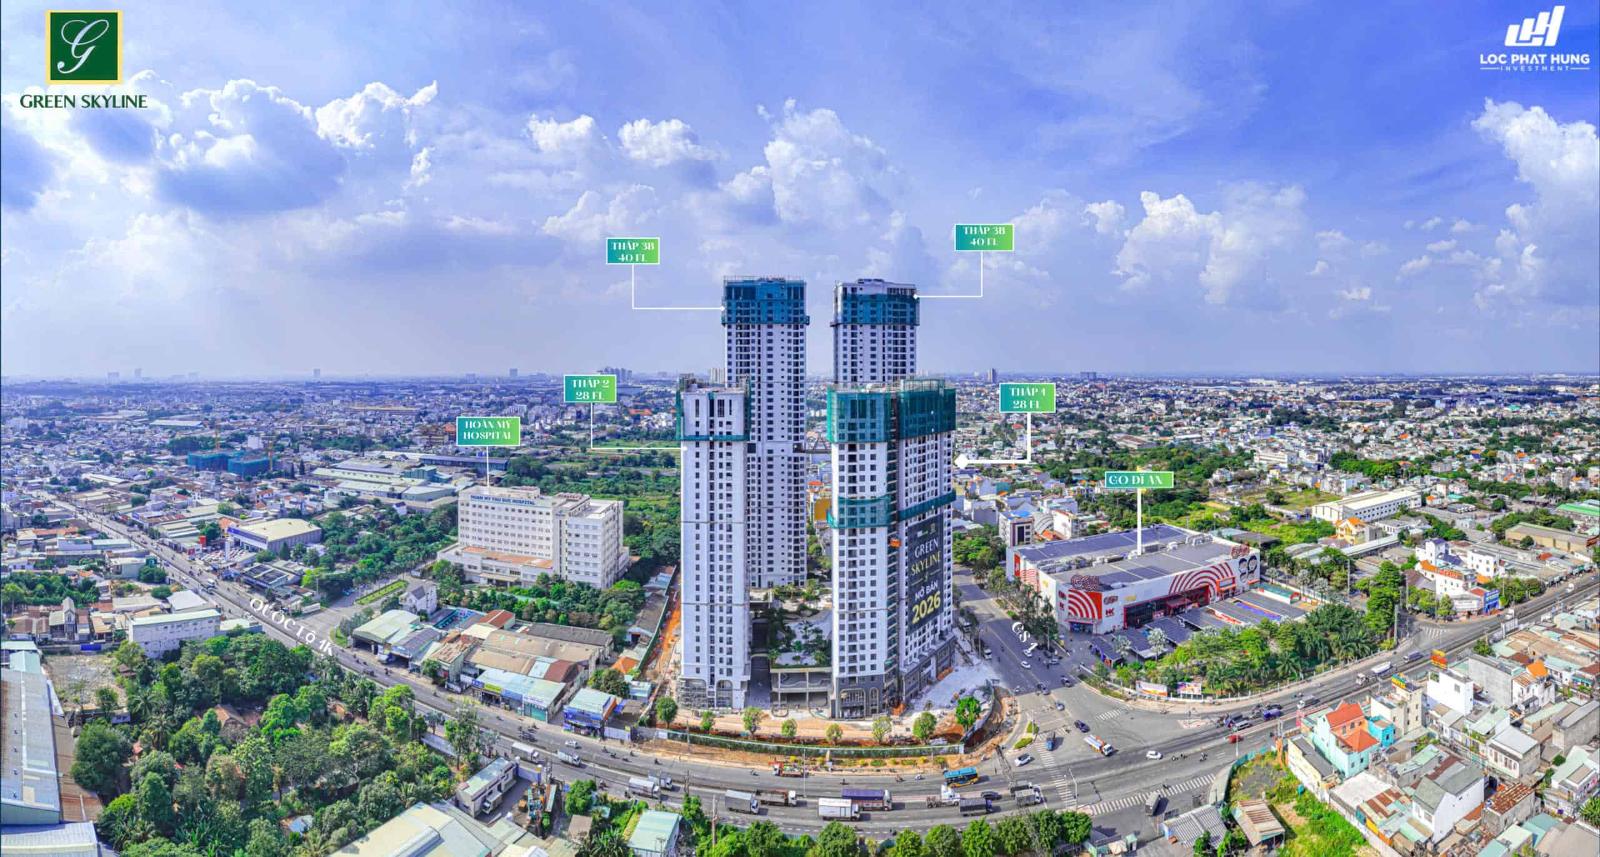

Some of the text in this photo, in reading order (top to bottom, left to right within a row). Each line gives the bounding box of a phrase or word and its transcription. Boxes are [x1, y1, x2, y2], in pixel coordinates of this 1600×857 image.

[914, 538, 940, 559] GREEN
[911, 551, 942, 577] SKYLINE
[911, 590, 941, 624] 2026
